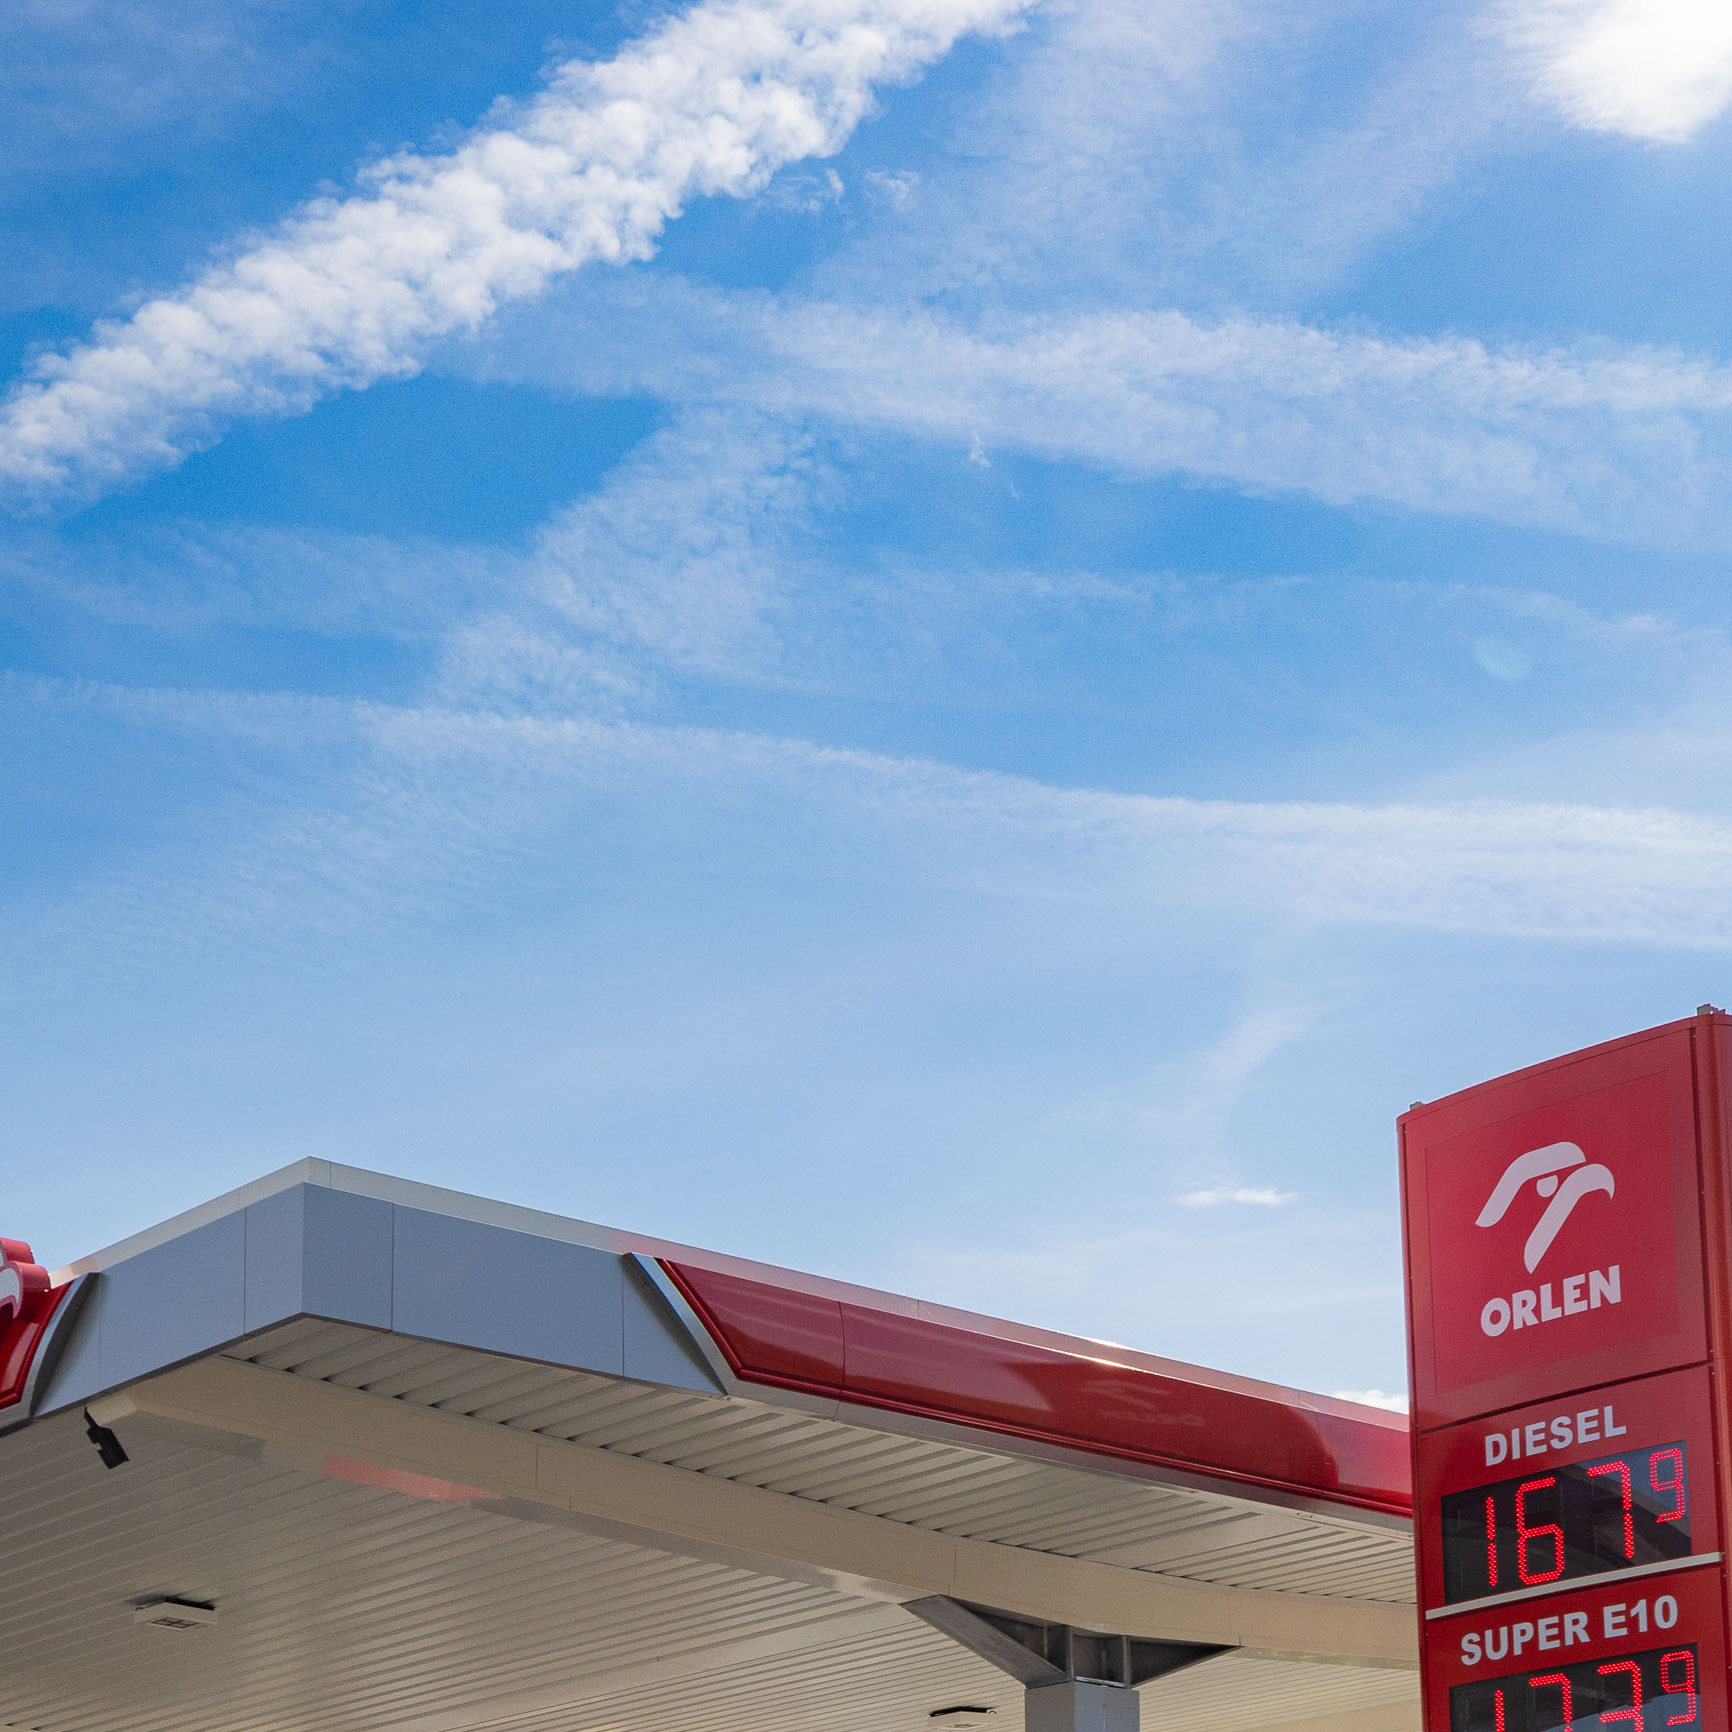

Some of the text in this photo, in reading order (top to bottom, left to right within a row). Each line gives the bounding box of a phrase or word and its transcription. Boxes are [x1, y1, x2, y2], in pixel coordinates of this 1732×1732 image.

[1480, 1265, 1621, 1337] ORLEN
[1485, 1405, 1627, 1467] DIESEL
[1461, 1595, 1678, 1666] SUPER E10
